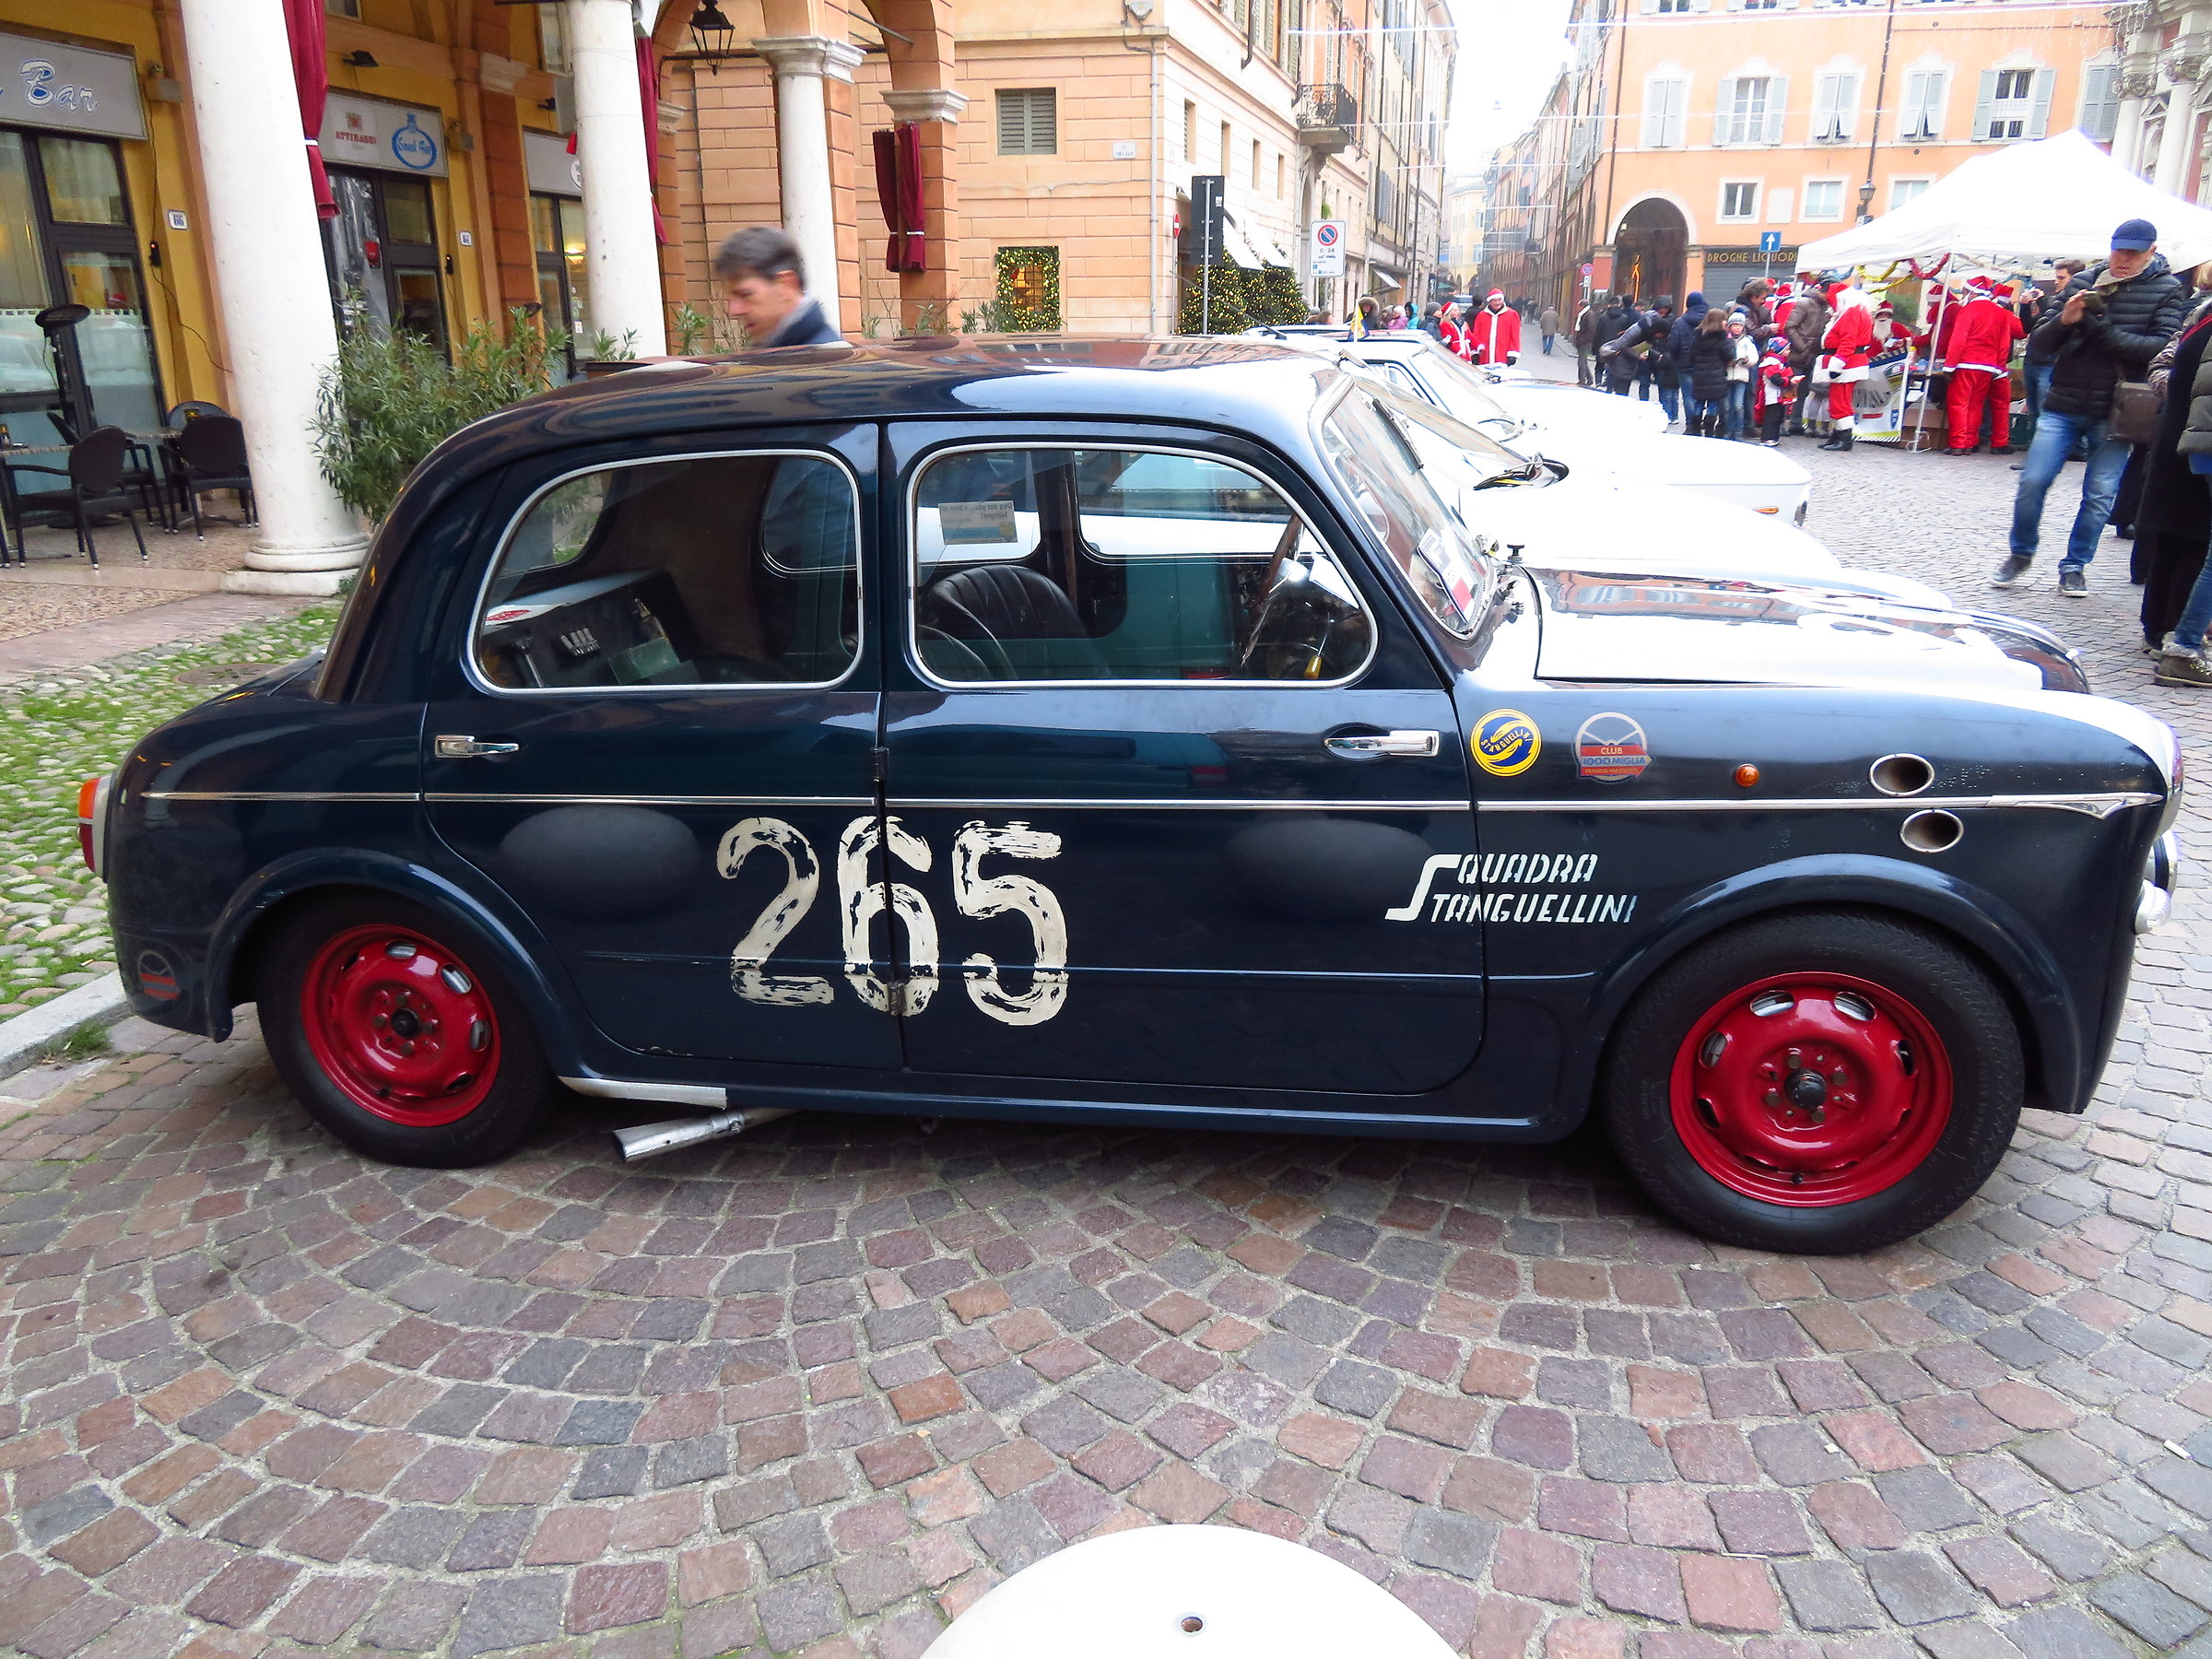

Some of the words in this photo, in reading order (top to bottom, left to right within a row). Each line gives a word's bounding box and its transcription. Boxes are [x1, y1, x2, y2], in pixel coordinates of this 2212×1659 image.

[18, 59, 99, 113] Bar
[1707, 253, 1747, 263] DROGHE
[1480, 728, 1534, 753] STANGUELLINI
[715, 816, 1068, 1026] 265
